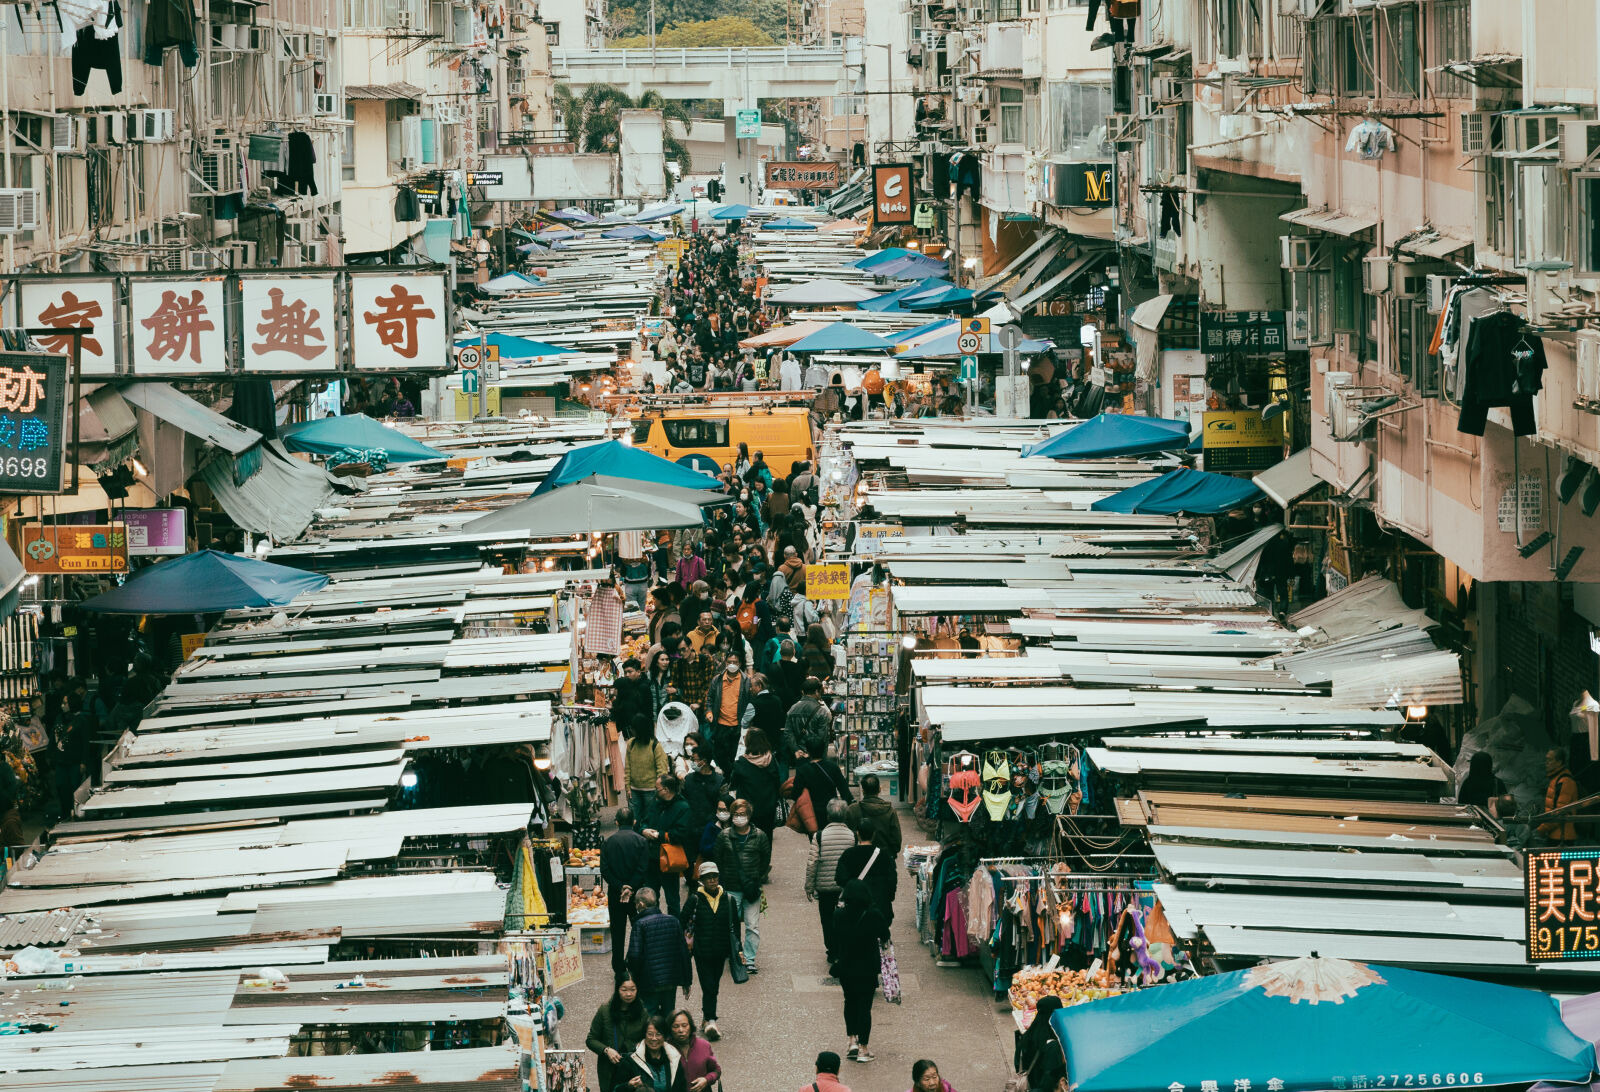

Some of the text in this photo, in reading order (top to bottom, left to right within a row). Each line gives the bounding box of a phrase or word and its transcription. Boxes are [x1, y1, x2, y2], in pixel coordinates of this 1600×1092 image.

[961, 338, 976, 348] 30
[462, 353, 478, 363] 30
[0, 457, 47, 477] 698
[61, 559, 125, 567] Fun In Lfe
[1539, 859, 1600, 922] 美足
[1538, 926, 1599, 952] 9175
